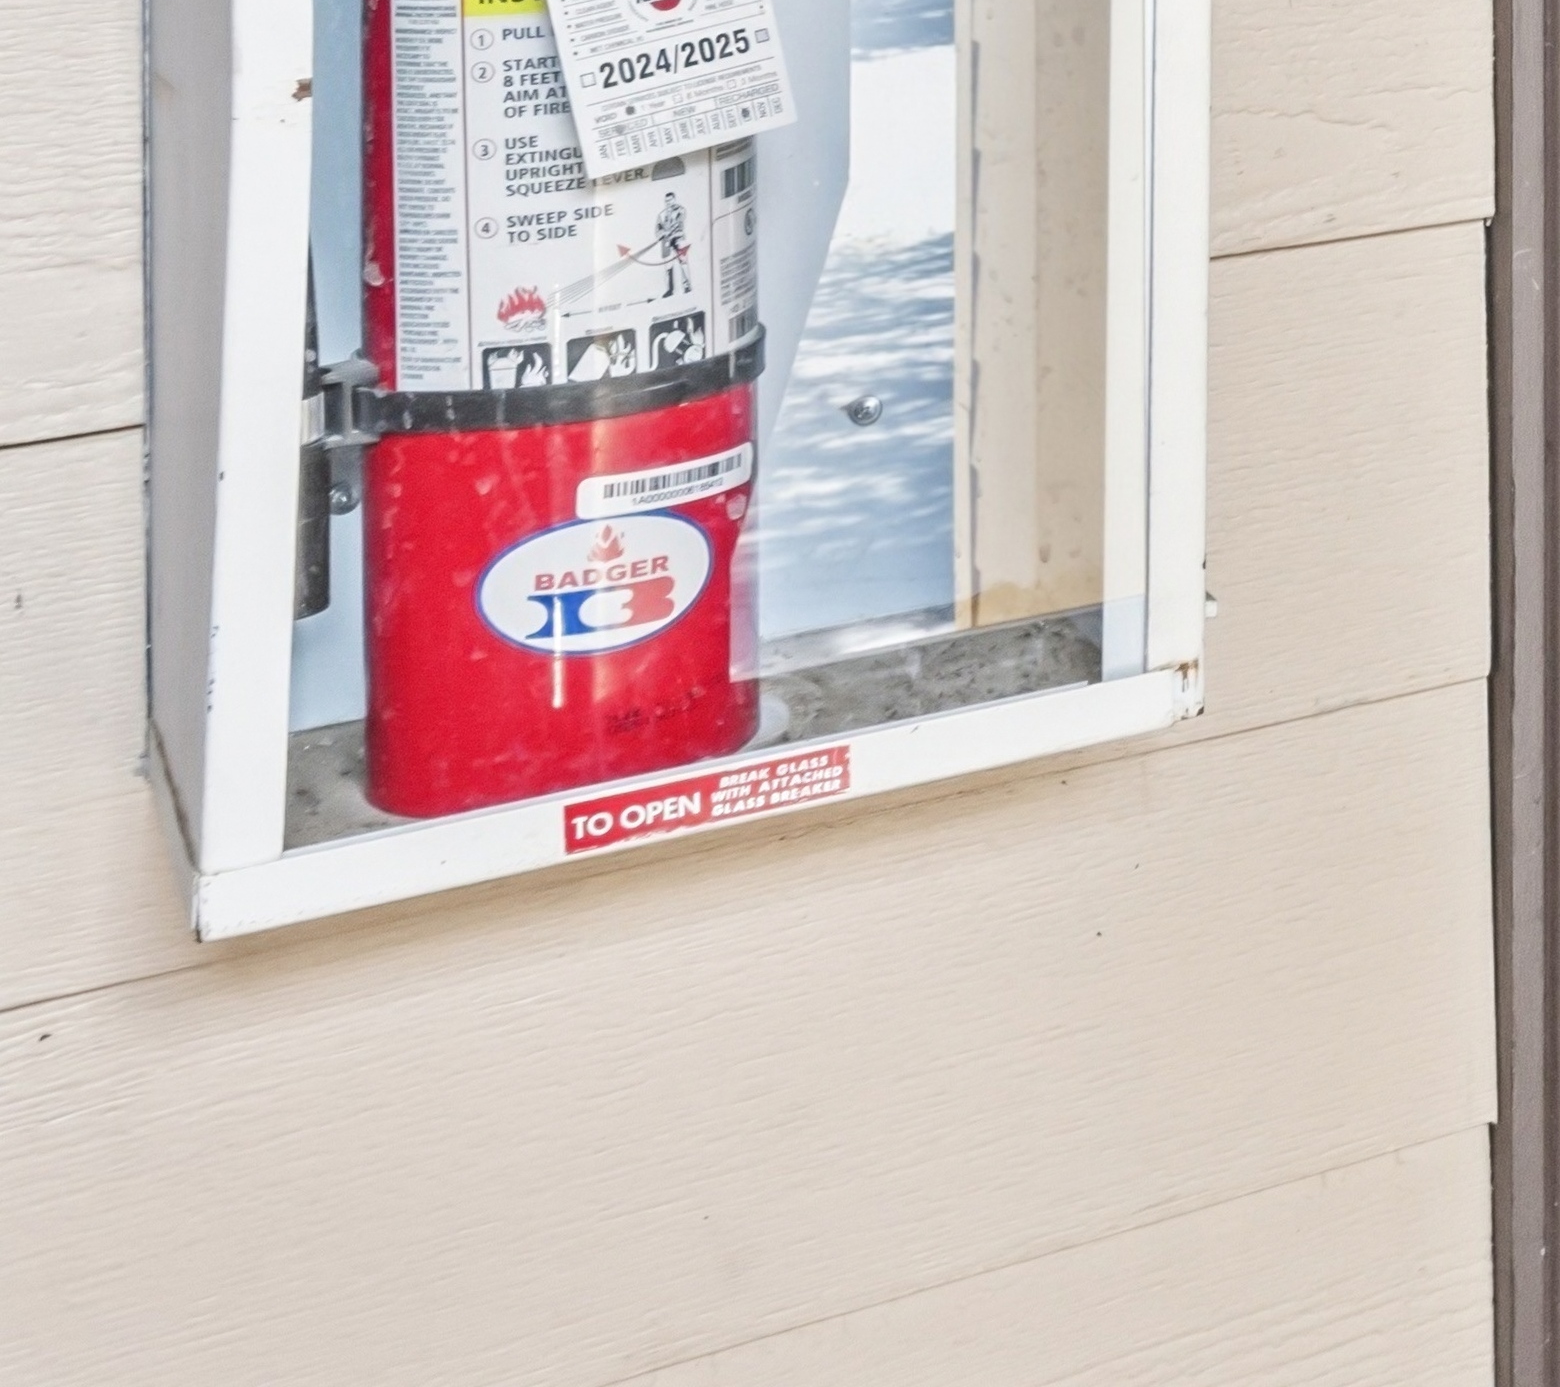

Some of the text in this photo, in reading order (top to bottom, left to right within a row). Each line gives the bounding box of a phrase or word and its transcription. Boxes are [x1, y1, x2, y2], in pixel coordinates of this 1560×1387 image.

[502, 26, 545, 41] PULL
[502, 56, 558, 72] START
[599, 28, 750, 89] 2024/2025
[503, 71, 561, 87] 8 FEET
[503, 86, 567, 103] AIM AT
[718, 83, 779, 105] RECHARGED
[504, 101, 570, 118] OF FIRE
[504, 135, 539, 150] USE
[505, 161, 584, 181] UPRIGHT
[506, 177, 586, 198] SQUEEZE
[506, 210, 568, 229] SWEEP
[574, 203, 614, 221] SIDE
[506, 224, 578, 244] TO SIDE
[534, 555, 670, 591] BADGER
[719, 755, 829, 788] BREAK GLASS
[711, 766, 843, 804] WITH ATTACHED
[711, 779, 841, 817] GLASS BREAKER
[570, 792, 701, 840] TO OPEN
